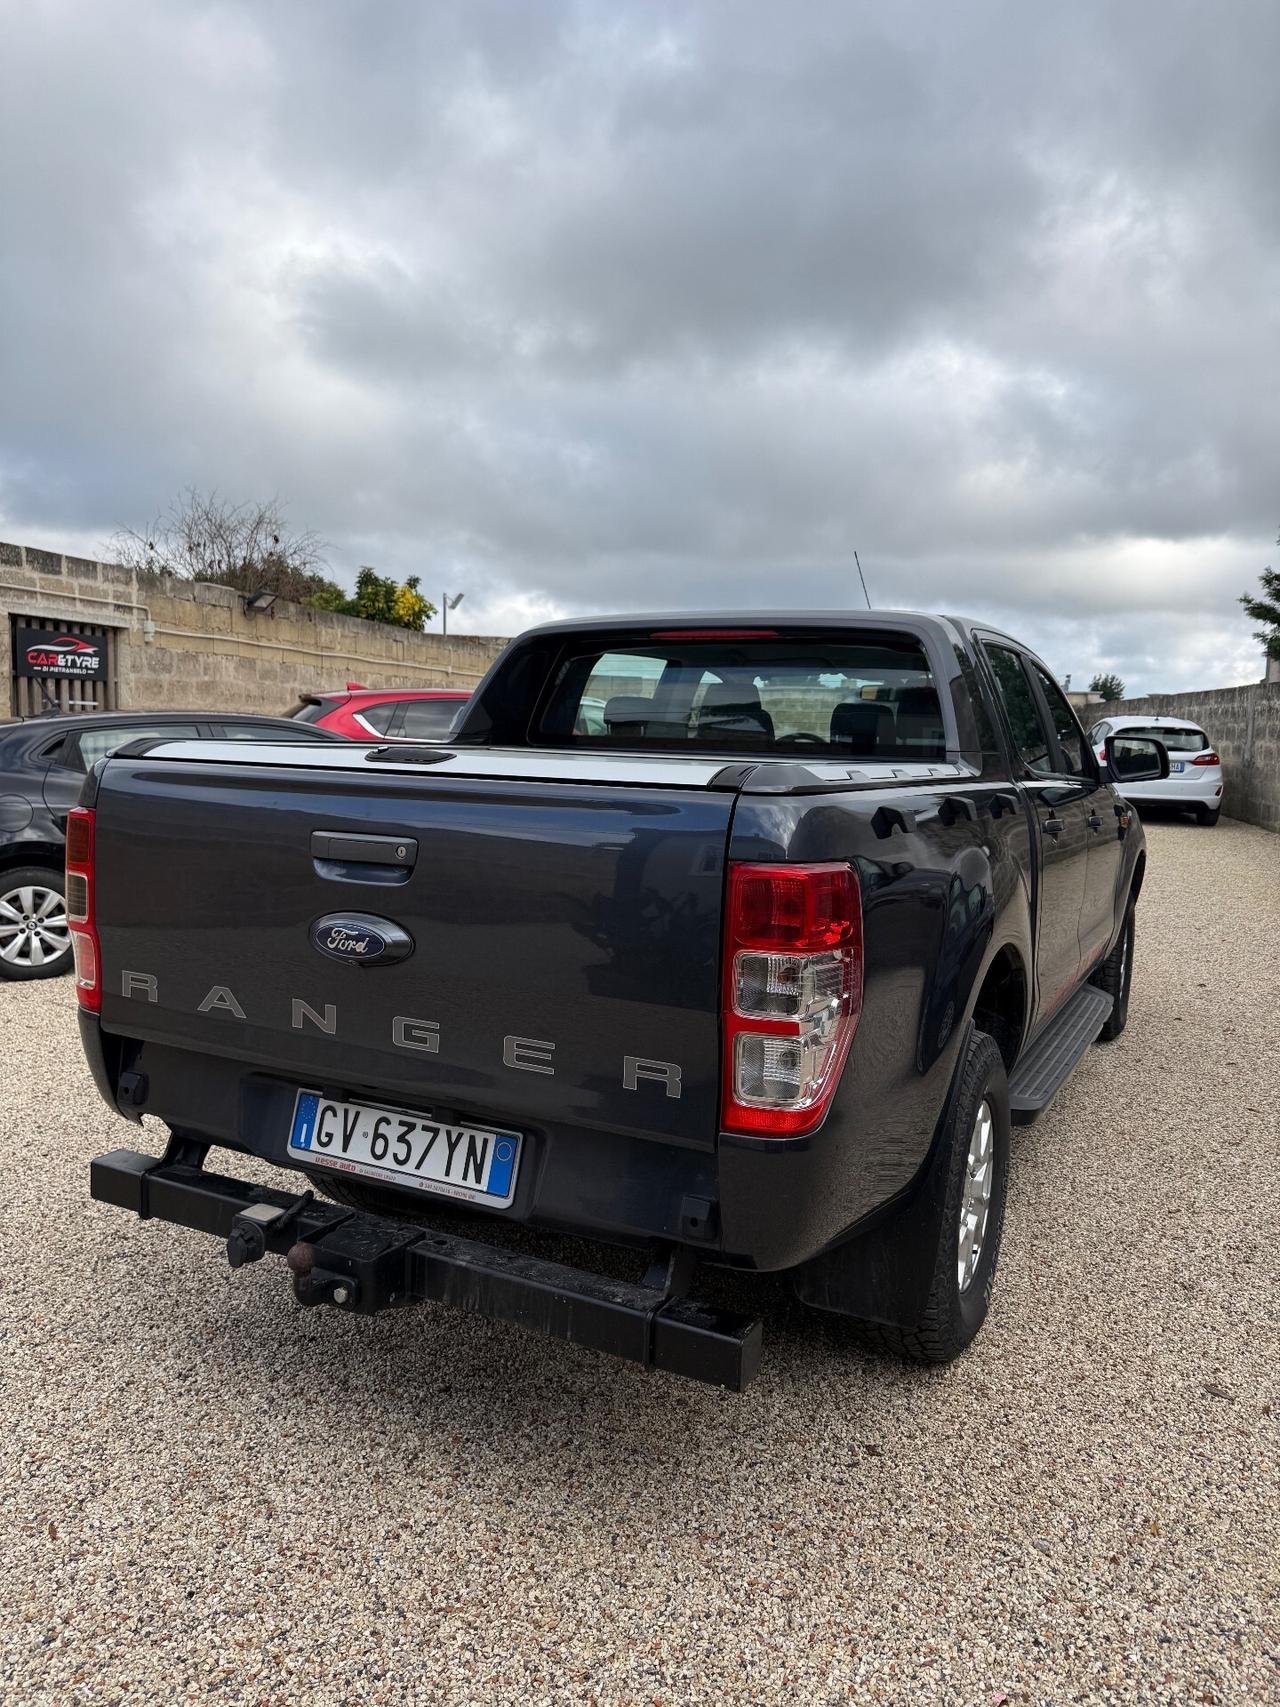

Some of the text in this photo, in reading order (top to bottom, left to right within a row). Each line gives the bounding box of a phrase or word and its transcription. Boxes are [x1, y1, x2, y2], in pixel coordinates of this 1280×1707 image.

[27, 651, 100, 668] CAR&TYRE
[327, 927, 369, 953] Ford
[121, 970, 682, 1098] RANGER
[316, 1105, 489, 1185] GV 637YN
